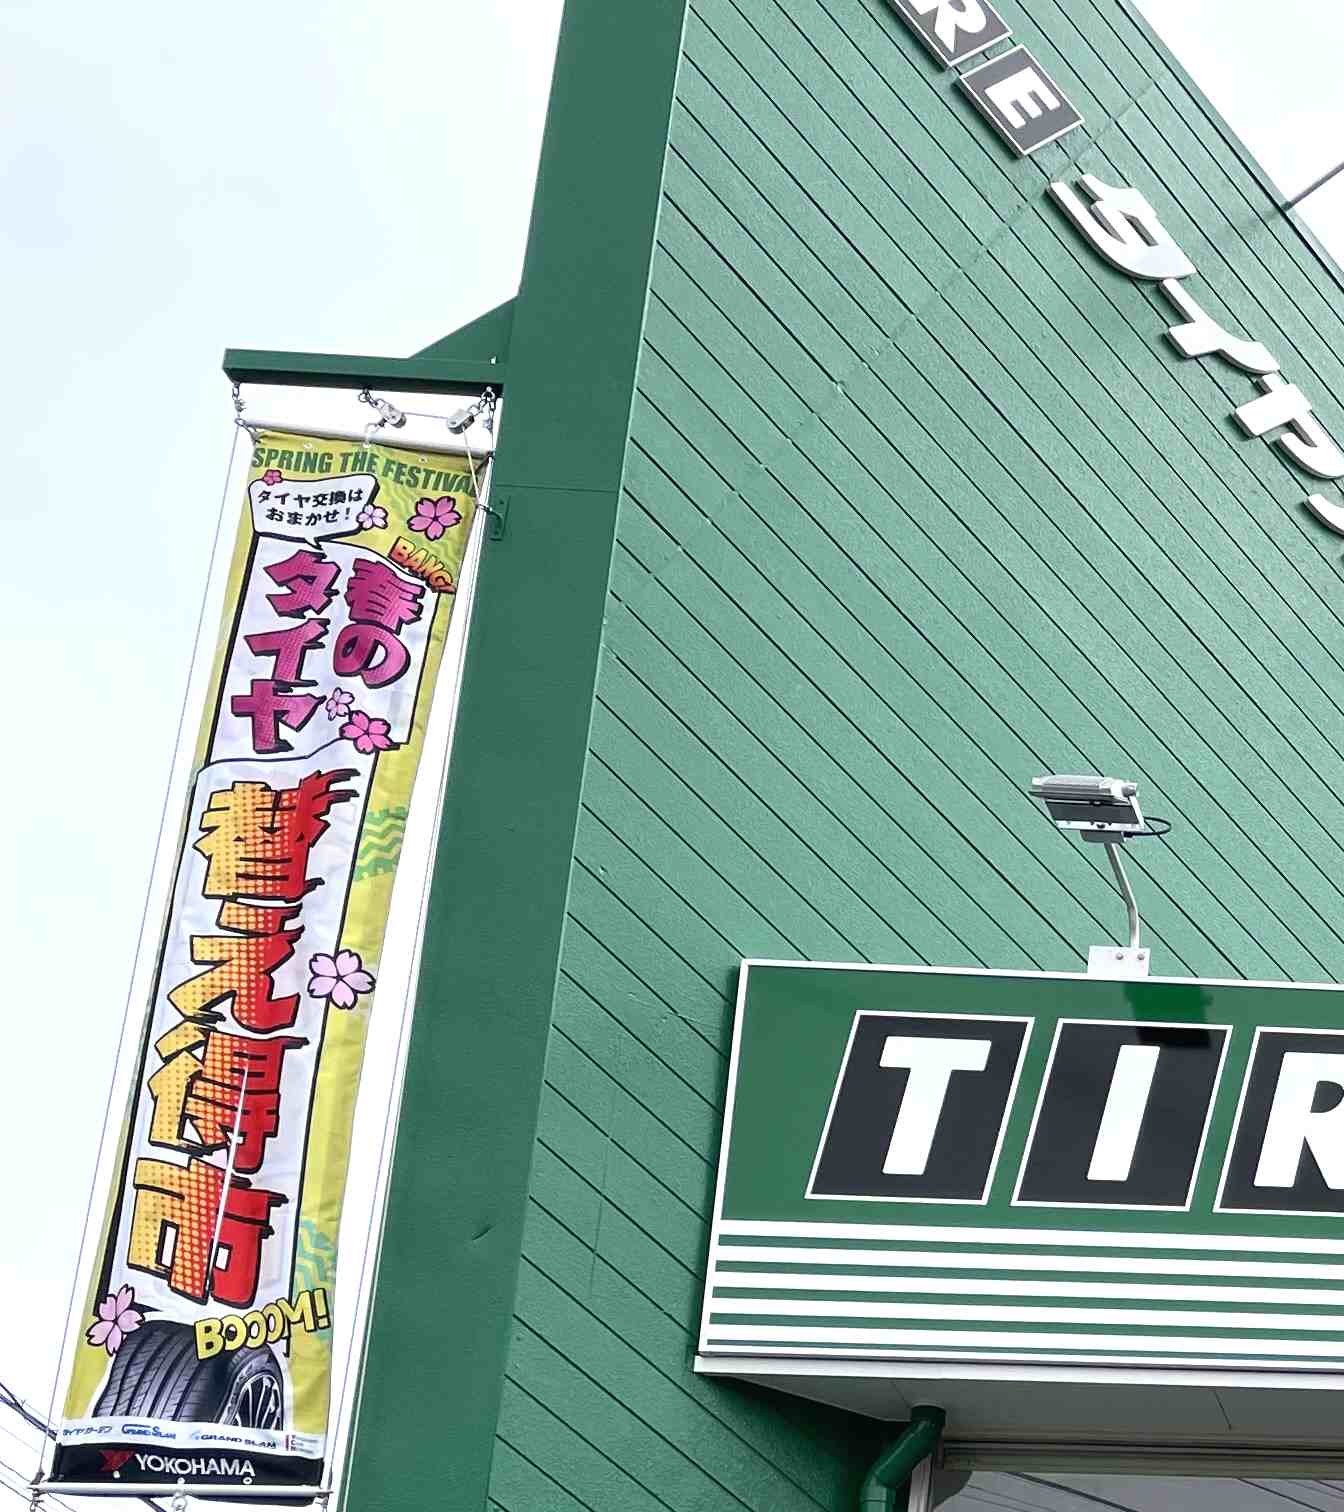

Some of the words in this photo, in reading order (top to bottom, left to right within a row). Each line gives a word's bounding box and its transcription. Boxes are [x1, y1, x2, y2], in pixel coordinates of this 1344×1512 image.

[252, 447, 332, 474] SPRING
[339, 451, 378, 476] THE
[258, 489, 363, 509] タイヤ交換は
[390, 537, 455, 593] BANG!
[126, 767, 361, 1308] 替え得市
[195, 1288, 330, 1360] BOOOM!
[135, 1453, 256, 1478] YOKOHAMA
